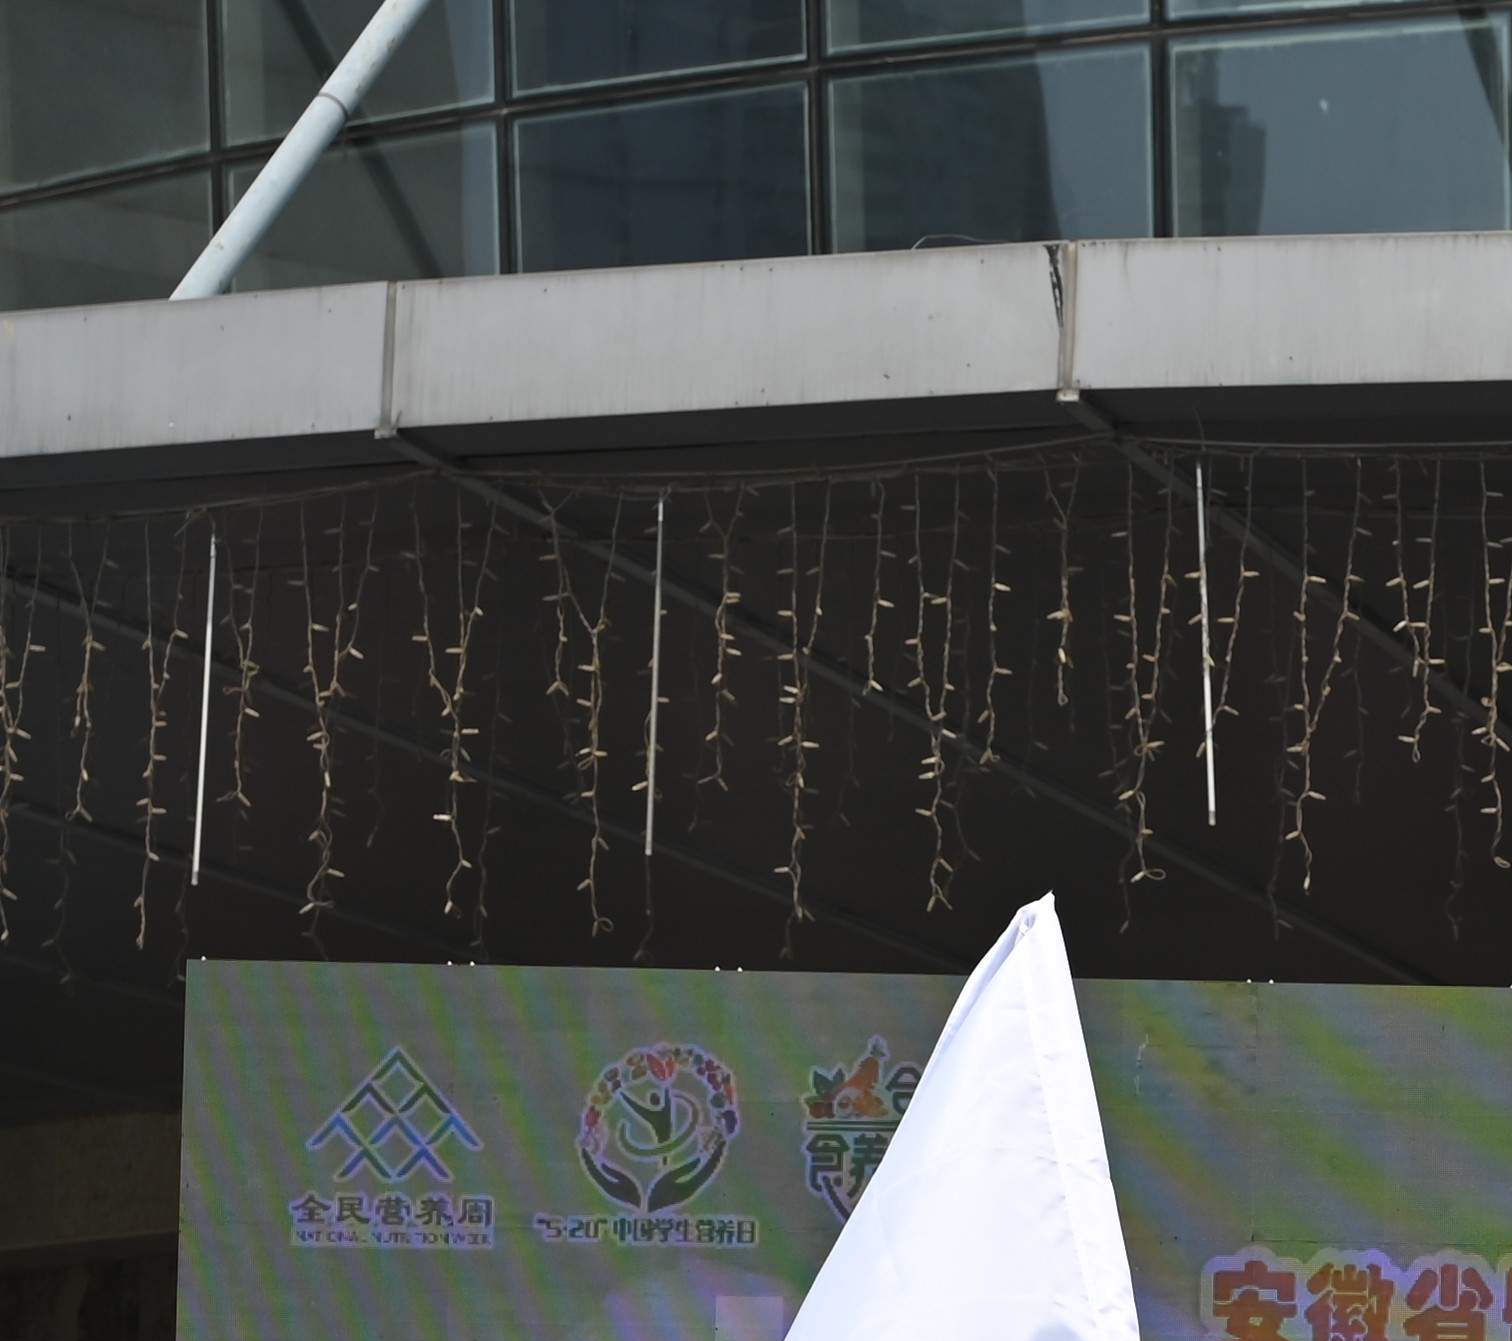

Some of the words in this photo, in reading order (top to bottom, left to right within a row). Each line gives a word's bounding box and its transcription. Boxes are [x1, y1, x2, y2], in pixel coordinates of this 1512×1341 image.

[292, 1193, 493, 1228] 全民营养周
